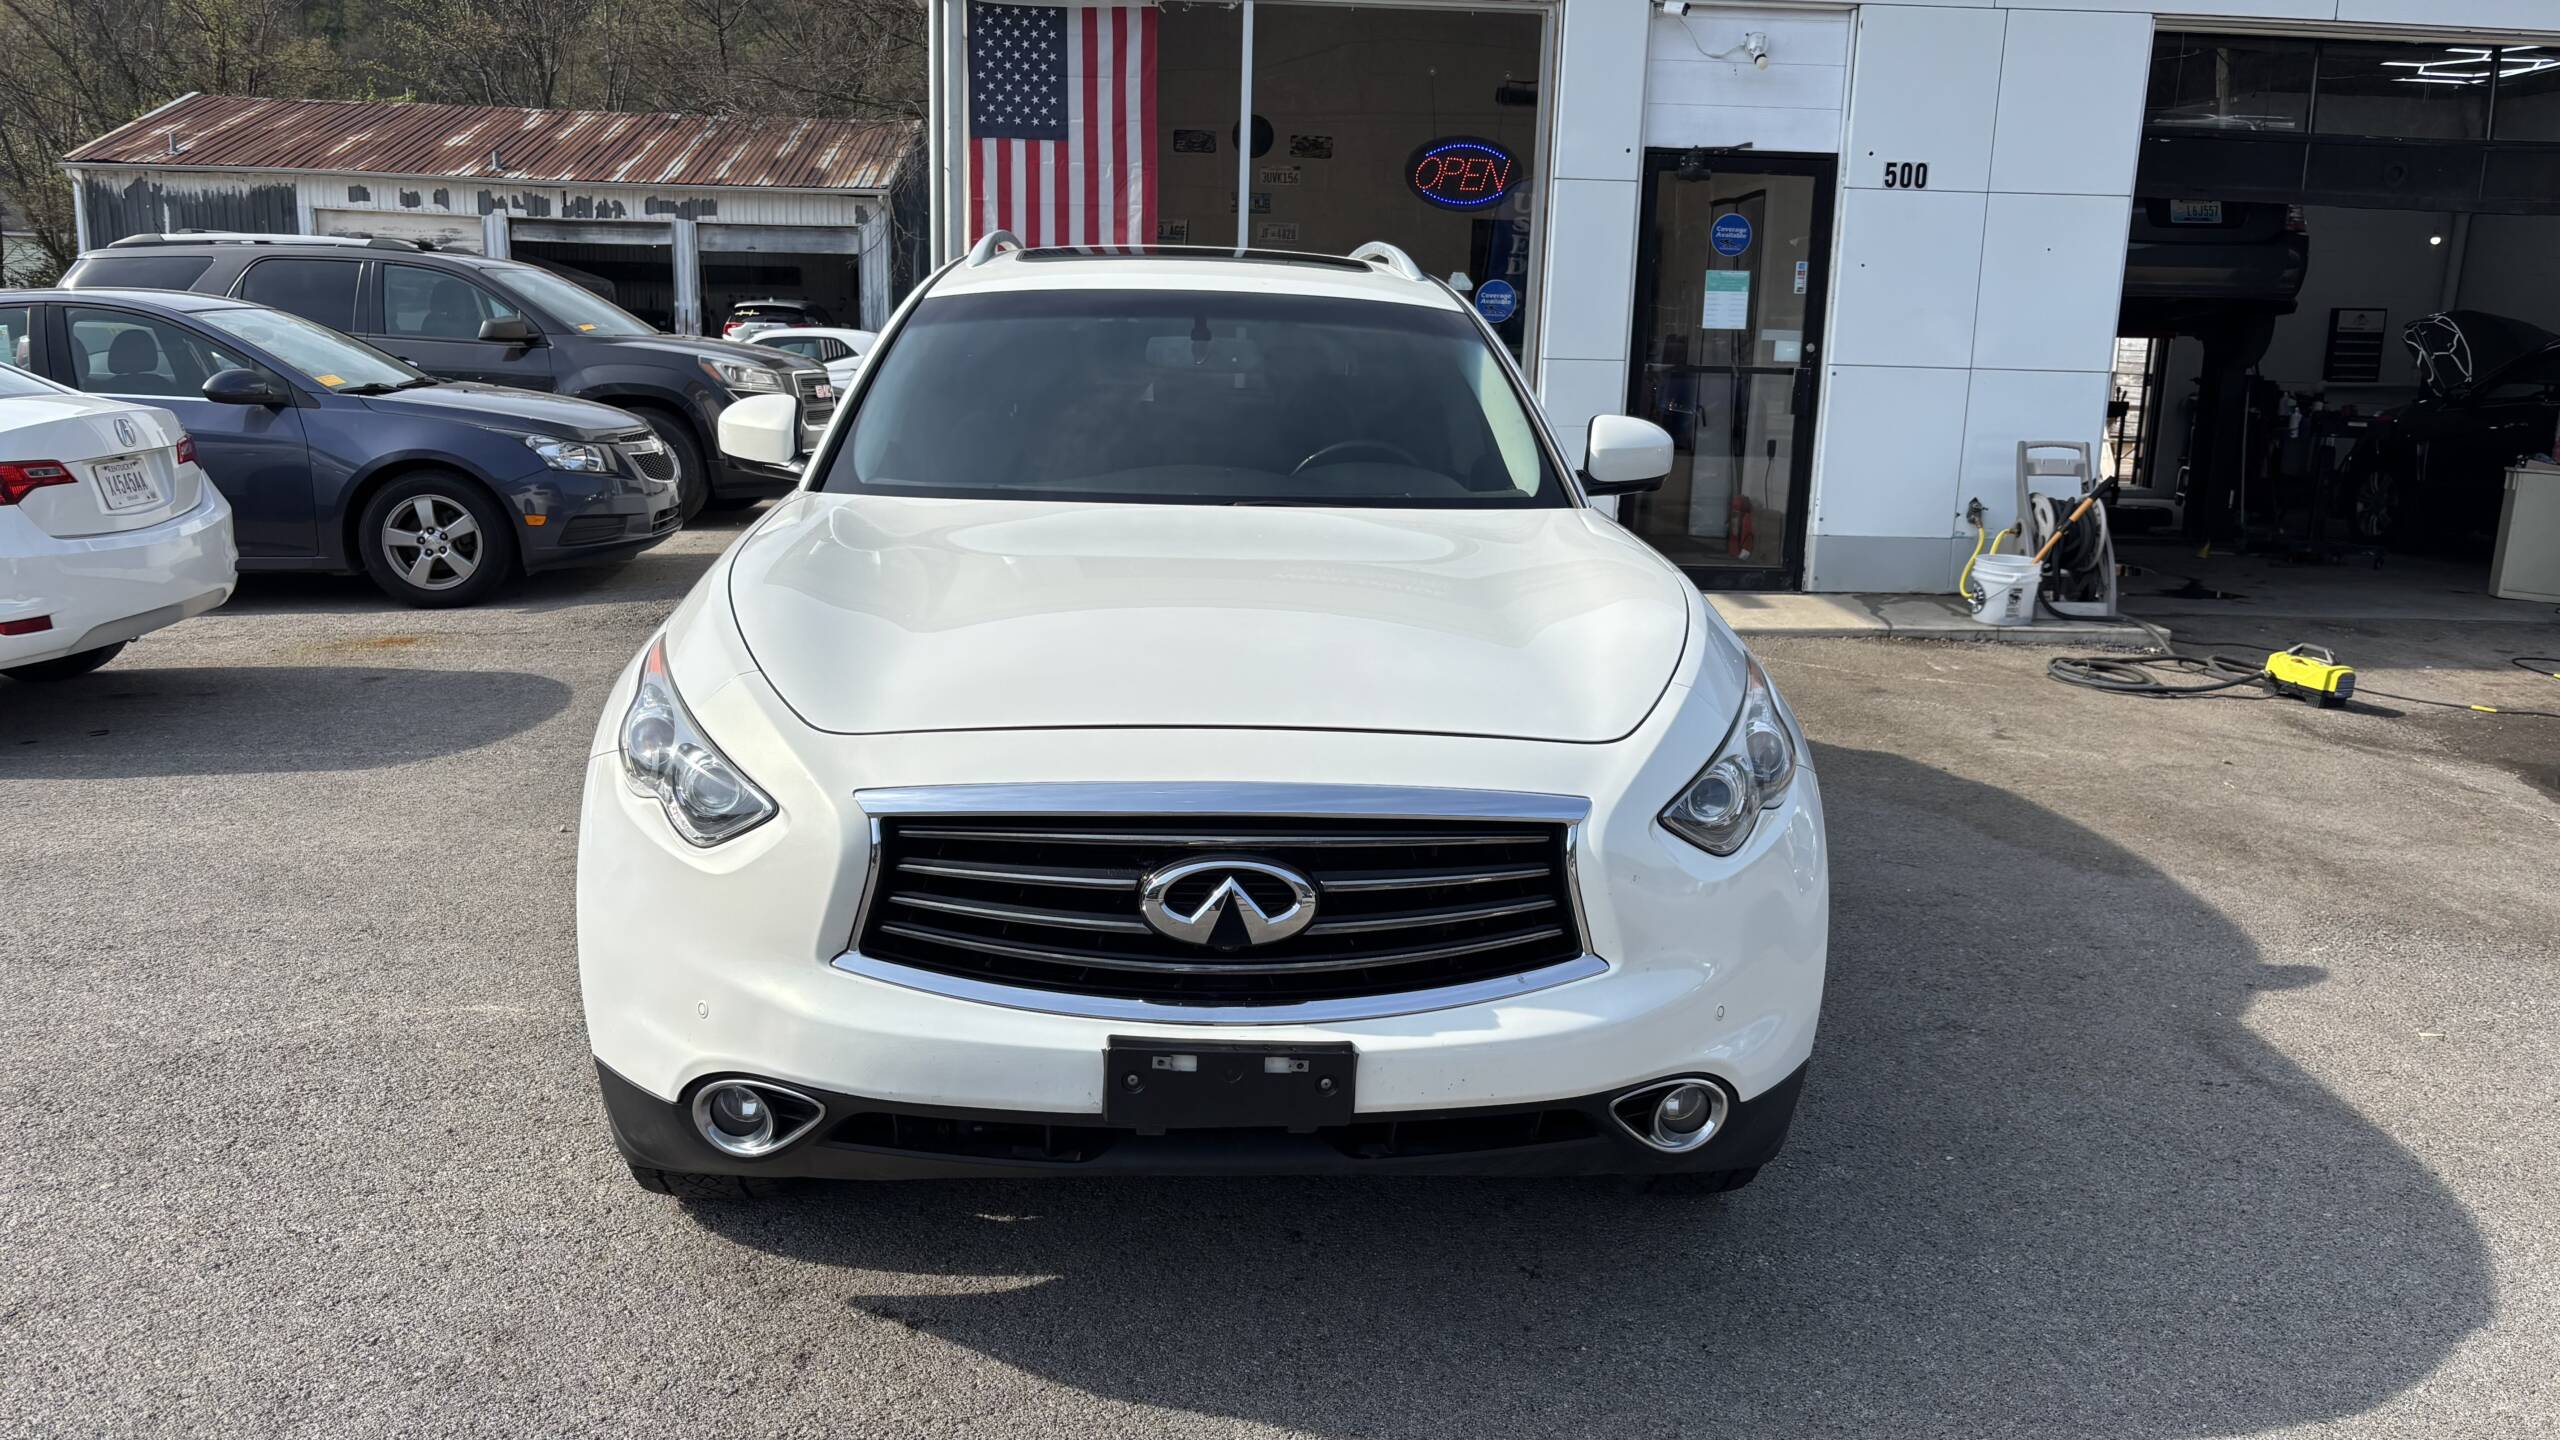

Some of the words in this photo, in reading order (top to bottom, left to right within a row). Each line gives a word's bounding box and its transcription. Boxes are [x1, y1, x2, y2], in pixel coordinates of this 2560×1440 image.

[1414, 156, 1512, 192] OPEN
[1884, 162, 1928, 189] 500
[1715, 226, 1748, 234] Coverage
[1480, 292, 1512, 300] Coverage
[105, 471, 149, 497] X4545AA
